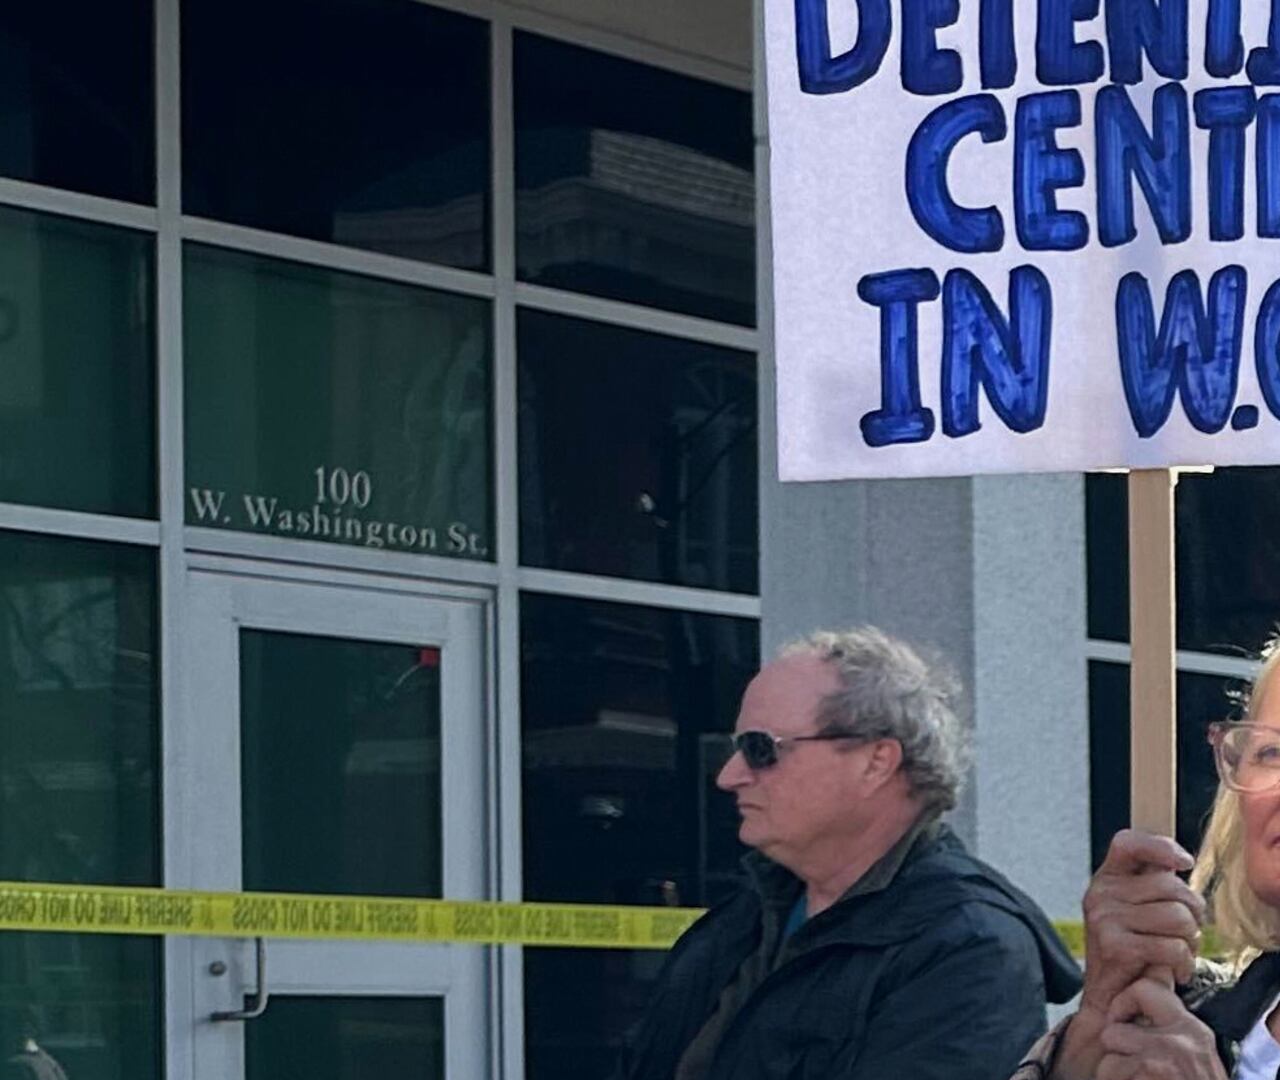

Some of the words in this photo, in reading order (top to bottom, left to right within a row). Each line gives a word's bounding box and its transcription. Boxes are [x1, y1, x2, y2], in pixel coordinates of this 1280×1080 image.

[857, 264, 1053, 447] IN
[314, 466, 372, 509] 100
[191, 488, 231, 524] W.
[244, 494, 437, 547] Washington
[449, 522, 488, 556] St.
